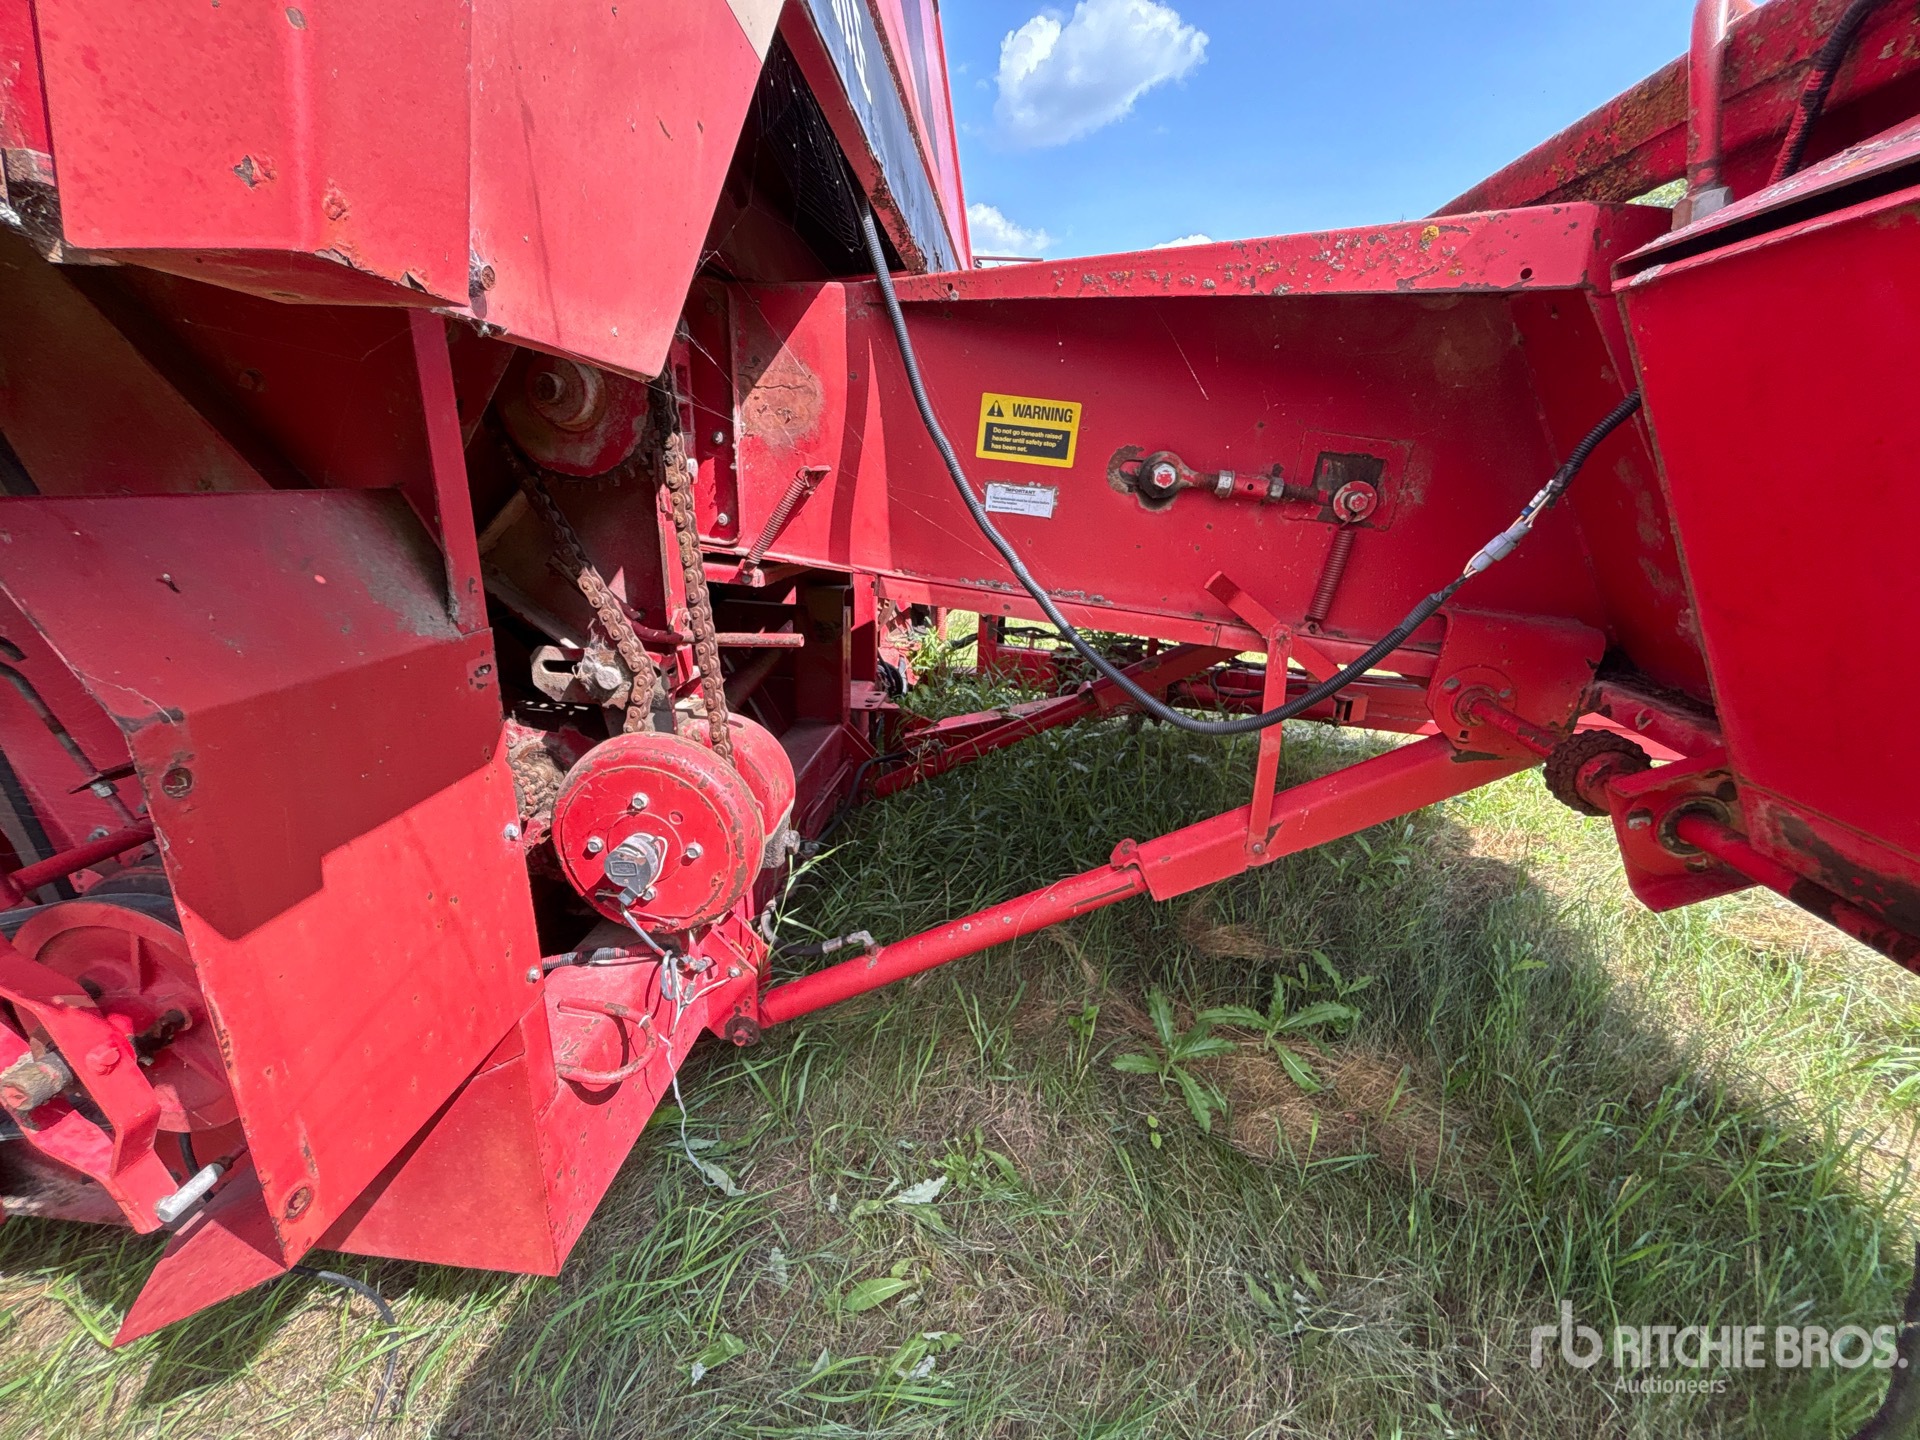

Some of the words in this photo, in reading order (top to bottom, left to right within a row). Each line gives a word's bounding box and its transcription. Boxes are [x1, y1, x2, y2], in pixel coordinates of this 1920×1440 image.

[1012, 403, 1073, 423] WARNING
[1021, 430, 1044, 438] beneath
[992, 435, 1012, 443] header
[1025, 438, 1042, 447] safety
[1043, 440, 1056, 448] stop
